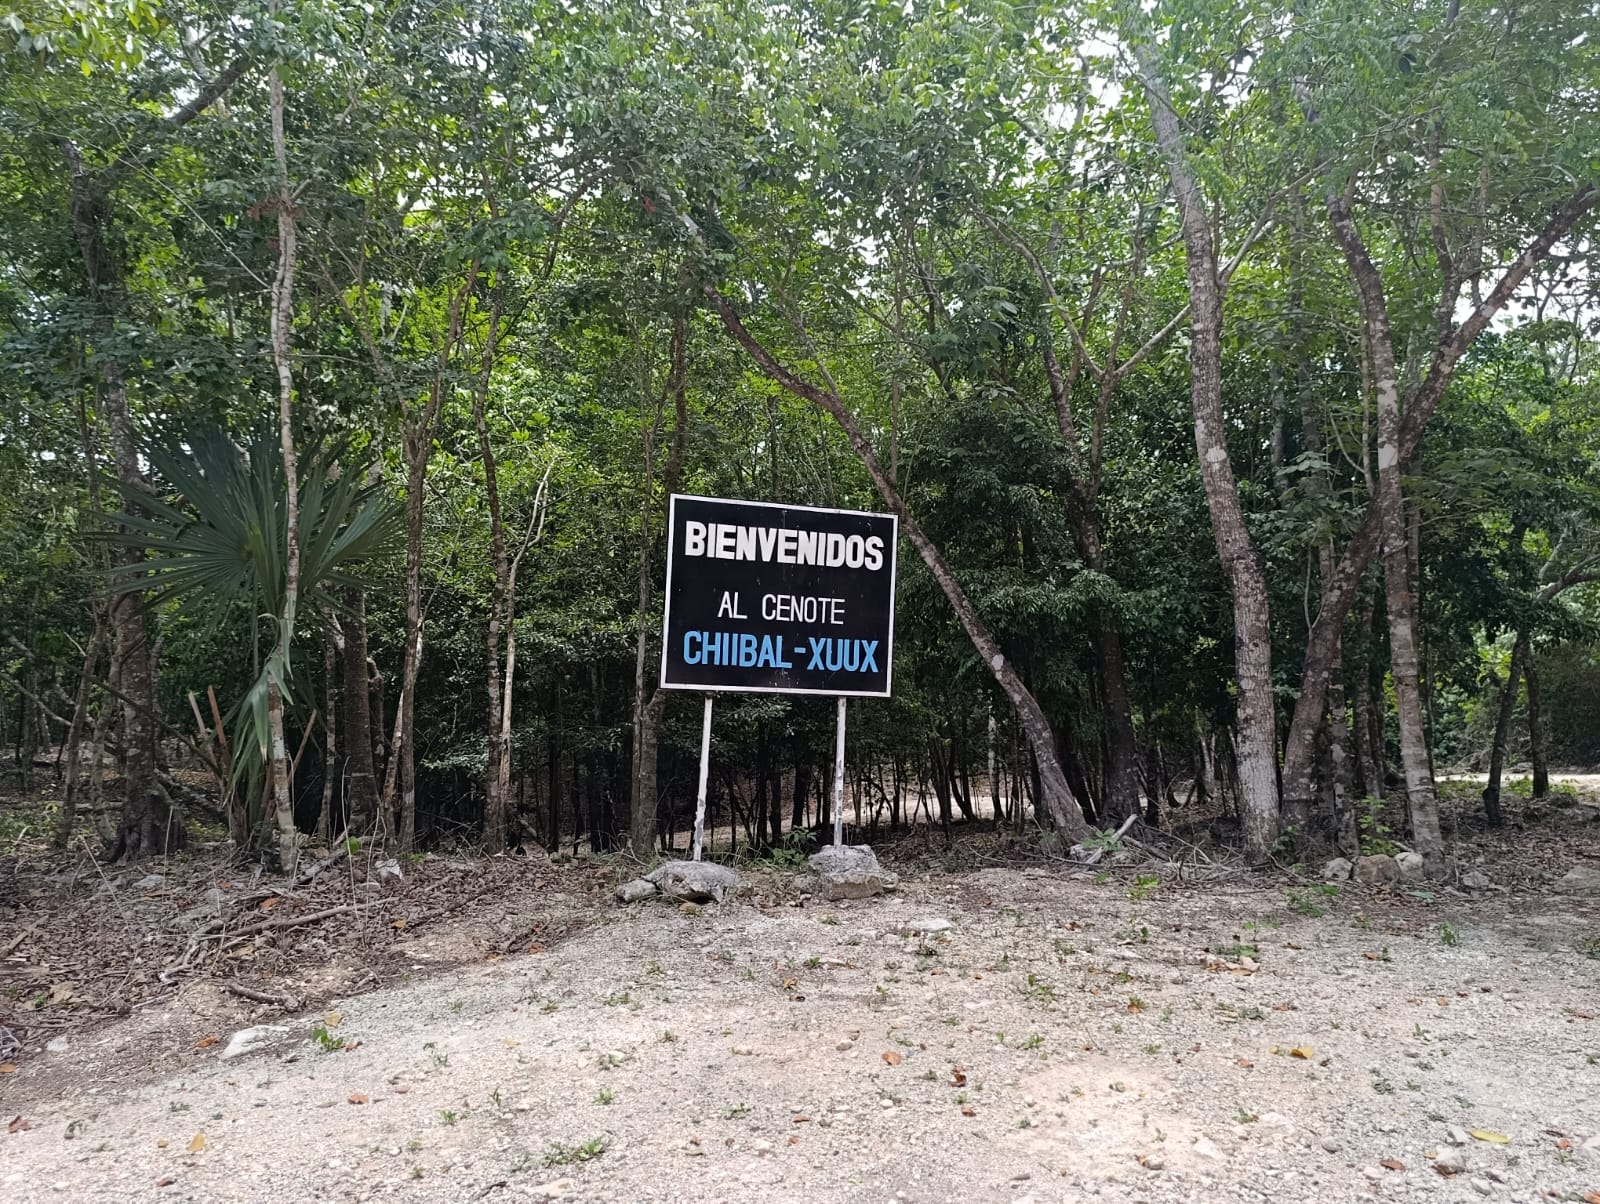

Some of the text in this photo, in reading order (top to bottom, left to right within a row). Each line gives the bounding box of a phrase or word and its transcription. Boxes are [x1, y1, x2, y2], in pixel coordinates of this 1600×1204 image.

[685, 520, 884, 570] BIENVENIDOS
[717, 591, 845, 624] AL CENOTE
